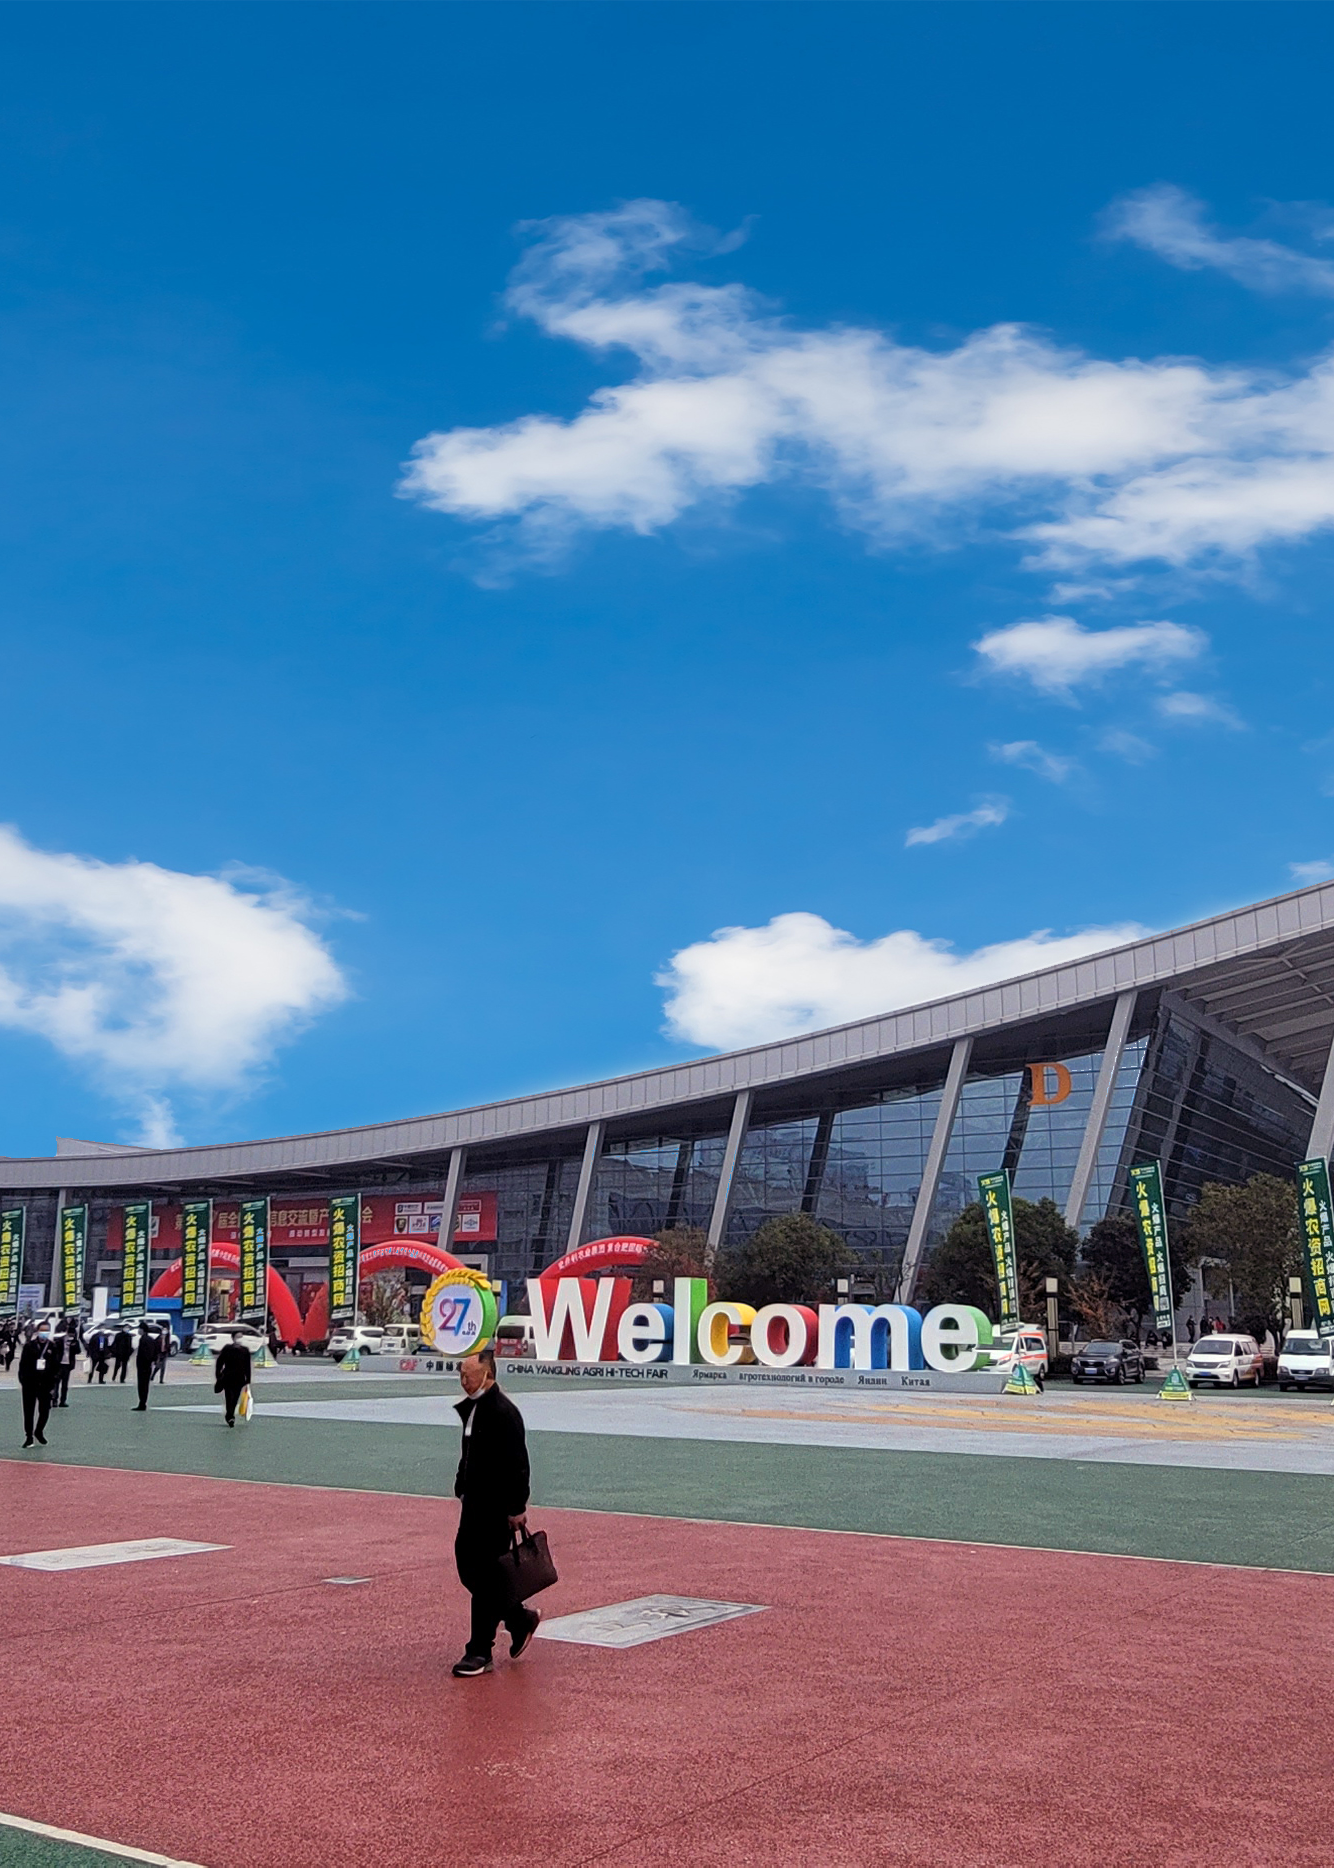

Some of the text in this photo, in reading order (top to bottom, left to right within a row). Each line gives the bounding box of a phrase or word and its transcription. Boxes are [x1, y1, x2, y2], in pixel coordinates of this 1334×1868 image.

[1025, 1062, 1071, 1105] D
[1302, 1178, 1331, 1316] 火爆农资招商网
[526, 1276, 994, 1373] Welcome
[506, 1363, 534, 1374] CHINA
[582, 1366, 604, 1377] AGRI
[606, 1367, 645, 1378] HI-TECH
[646, 1369, 669, 1379] FAIR
[692, 1368, 727, 1381] Ярмарка
[901, 1375, 931, 1387] Китая
